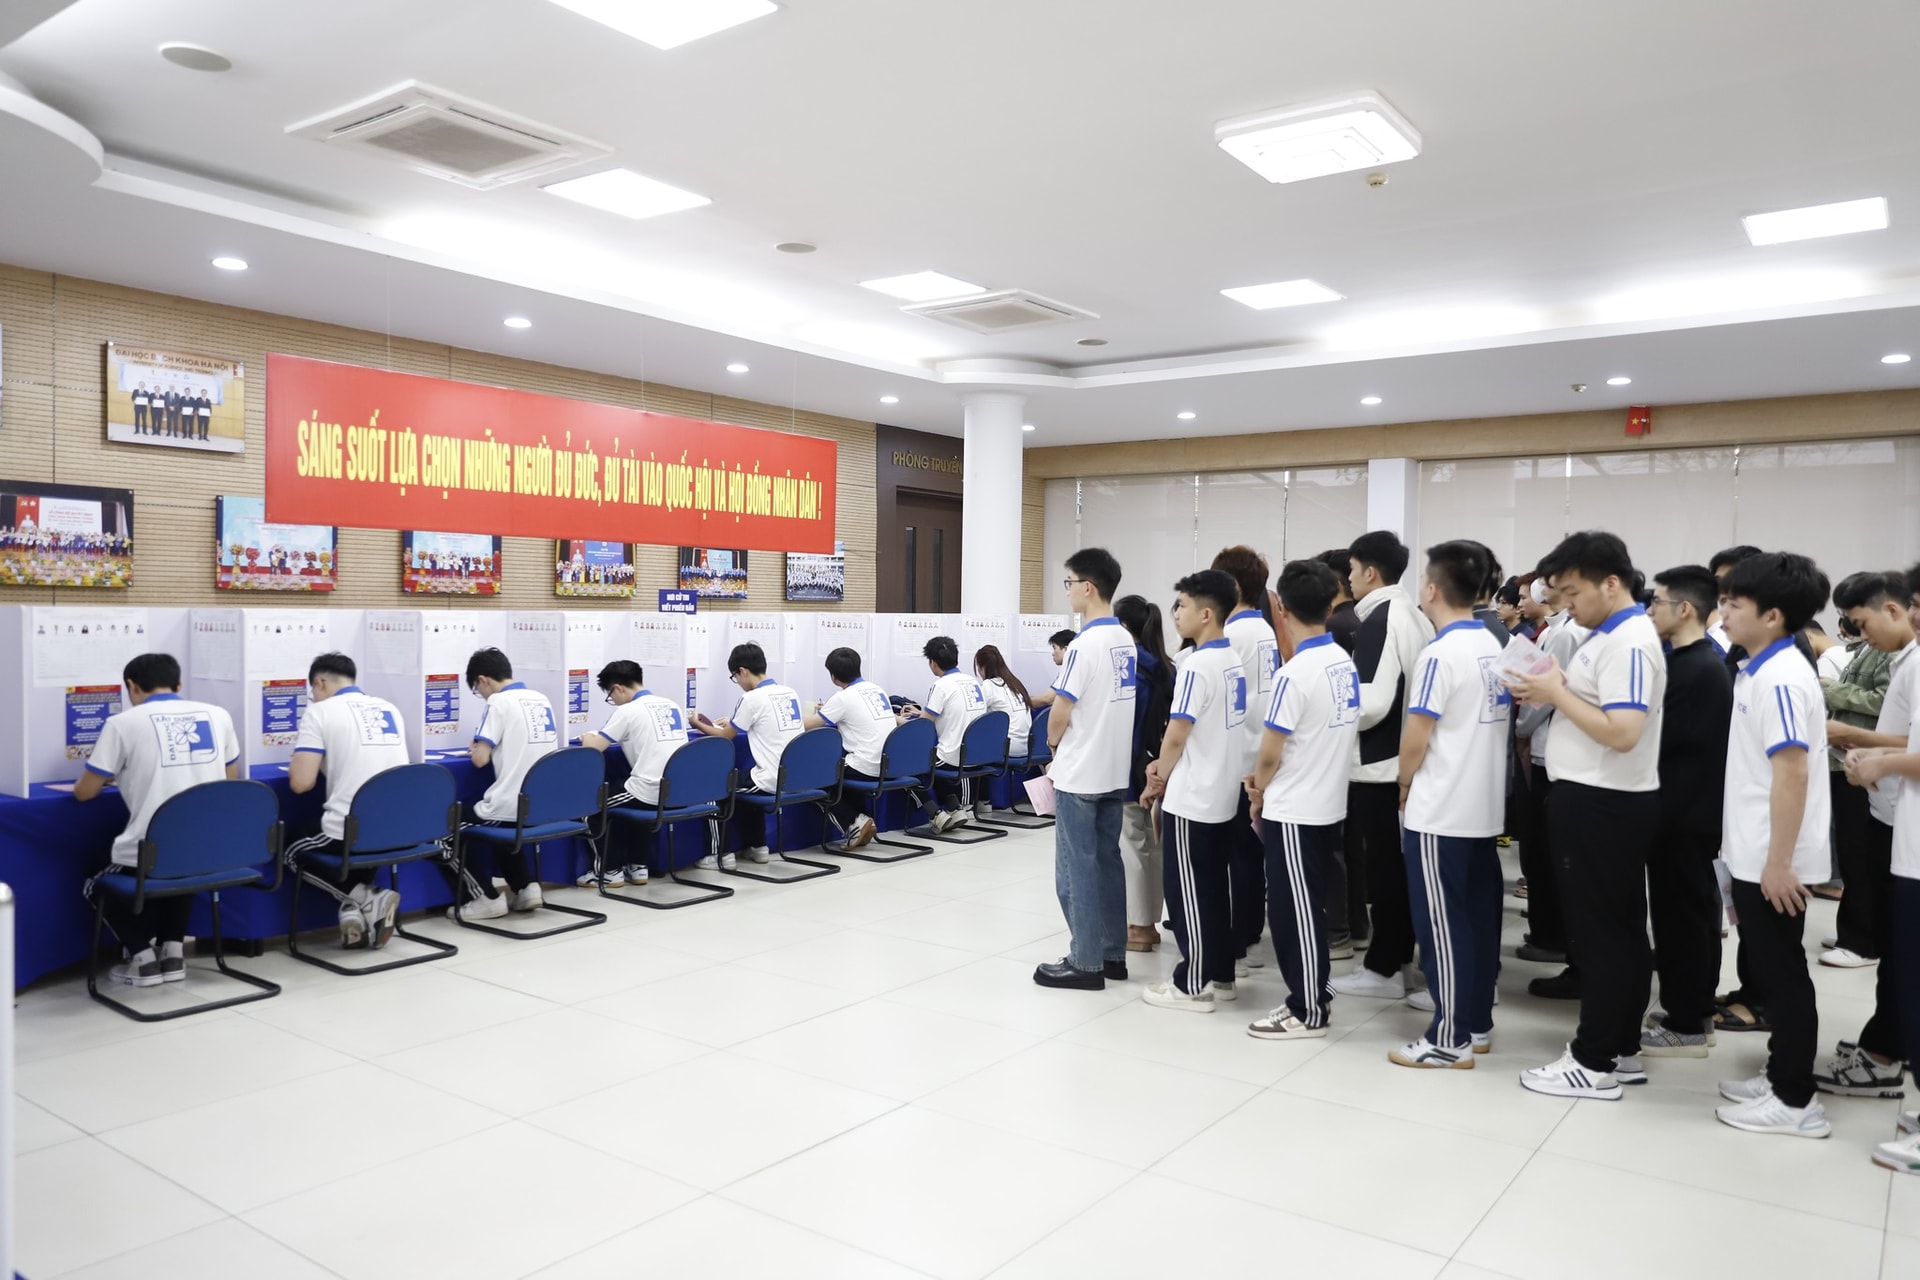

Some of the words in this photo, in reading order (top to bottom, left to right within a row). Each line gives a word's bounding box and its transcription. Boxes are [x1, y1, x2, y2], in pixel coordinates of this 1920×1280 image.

[297, 409, 343, 480] SÁNG
[346, 409, 387, 483] SUỐT
[389, 426, 419, 496] LỰA
[422, 434, 462, 500] CHỌN
[464, 428, 511, 493] NHỮNG
[513, 434, 553, 497] NGƯỜI
[555, 430, 573, 499] ĐỦ
[574, 439, 602, 507] ĐỨC,
[604, 436, 620, 503] ĐỦ
[622, 448, 640, 504] TÀI
[642, 451, 664, 507] VÀO
[665, 449, 693, 512] QUỐC
[695, 457, 712, 520] HỘI
[713, 460, 727, 512] VÀ
[728, 462, 745, 523] HỘI
[745, 459, 771, 516] ĐỒNG
[772, 469, 798, 519] NHÂN
[798, 471, 817, 520] DÂN
[892, 449, 929, 470] PHÒNG
